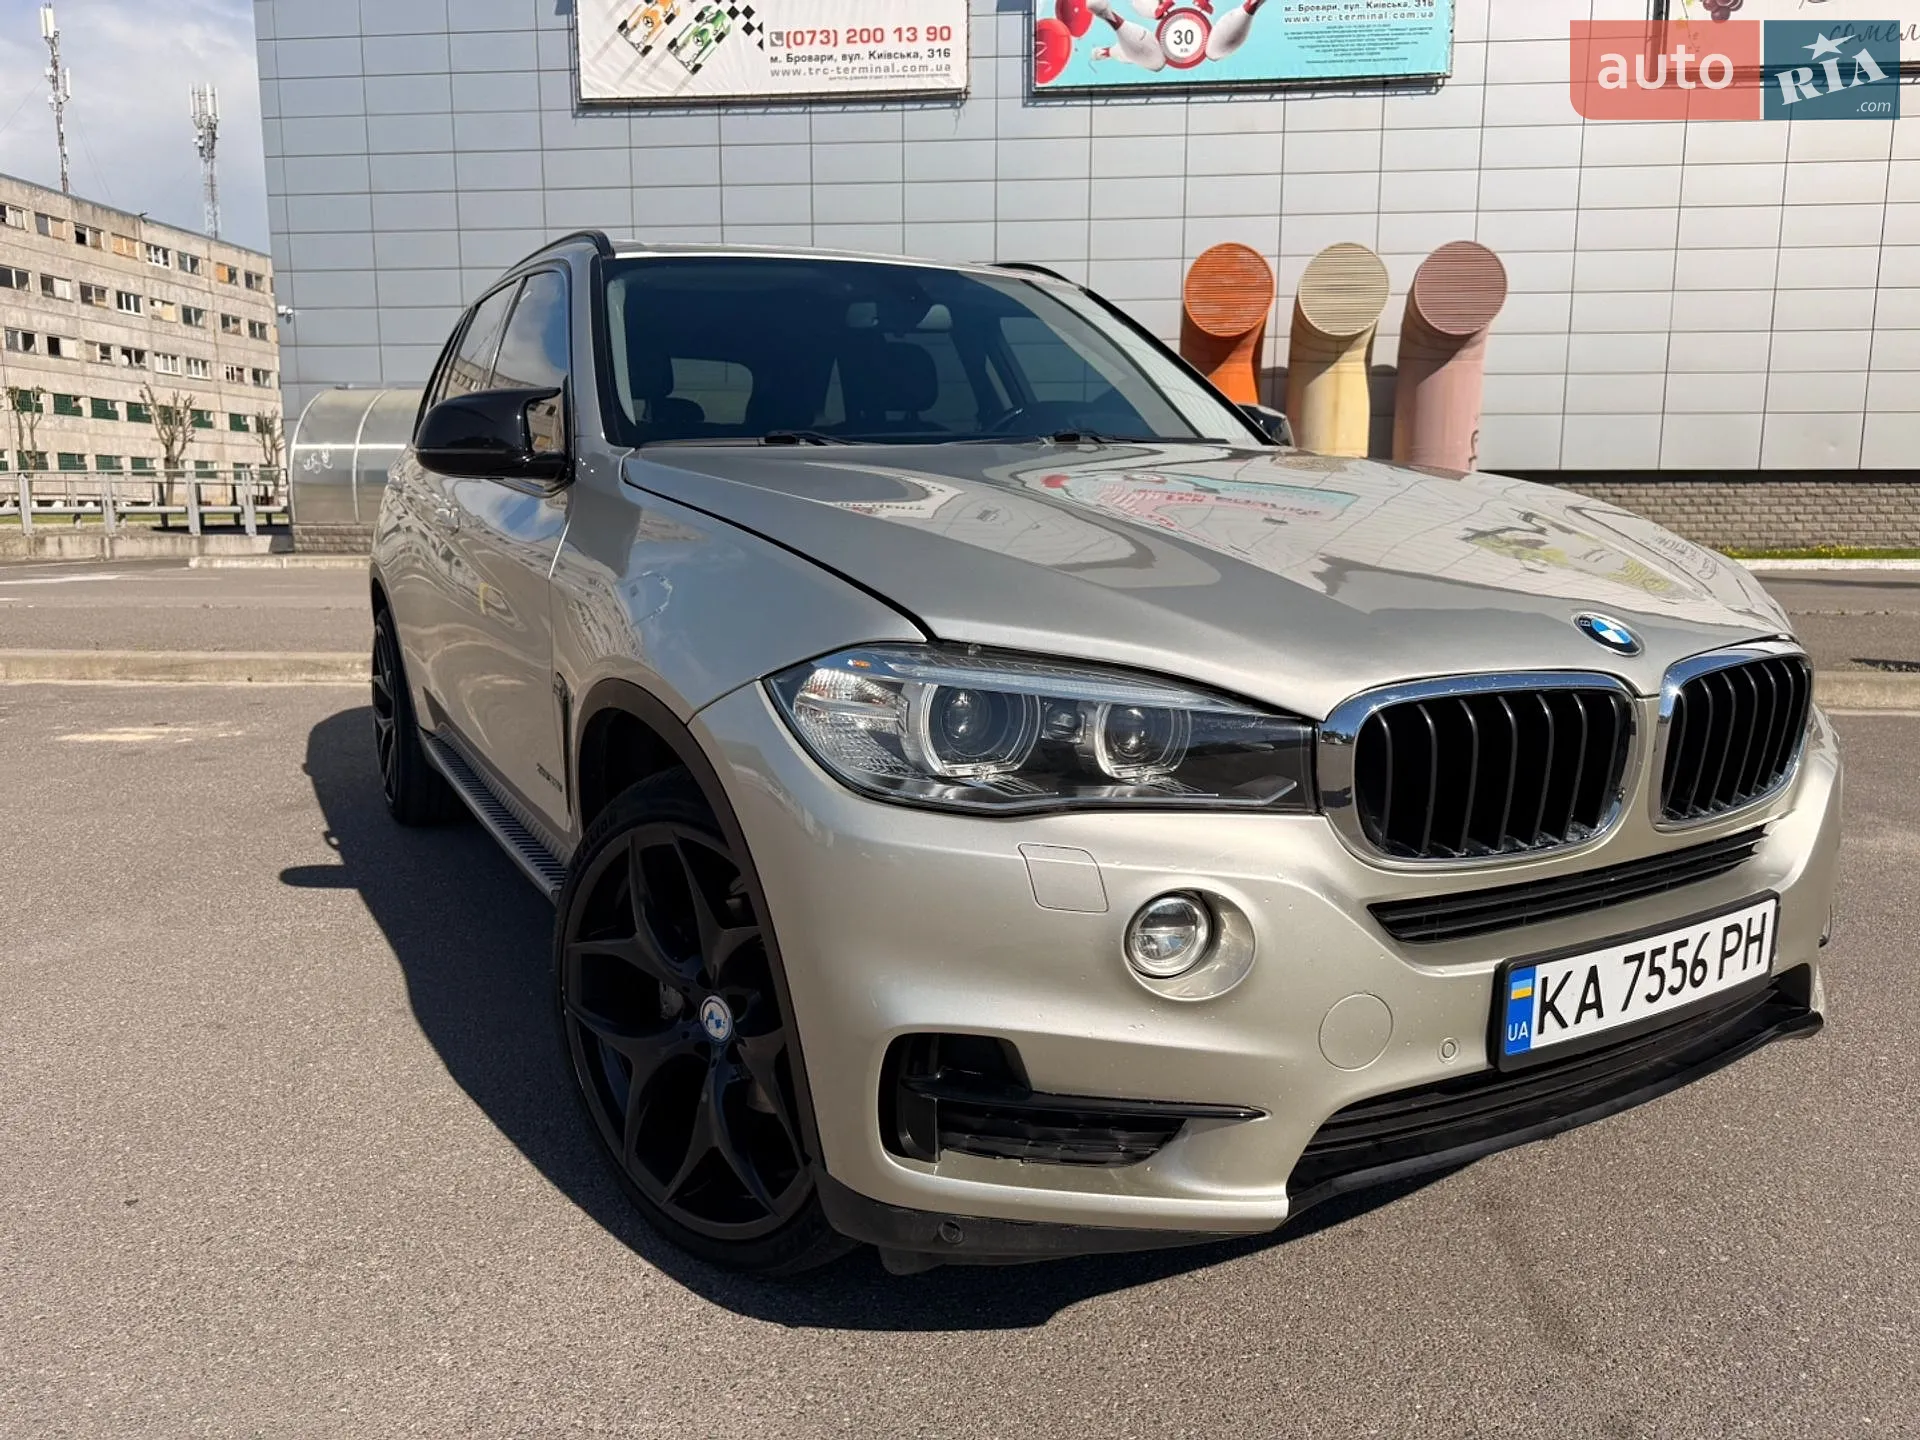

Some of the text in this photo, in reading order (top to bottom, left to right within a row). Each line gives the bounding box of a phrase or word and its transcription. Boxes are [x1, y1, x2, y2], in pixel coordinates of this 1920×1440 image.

[1284, 11, 1434, 23] www.trc-terminal.com.ua
[785, 25, 952, 49] (073) 200 13 90
[1173, 29, 1194, 45] 30
[770, 55, 782, 64] м.
[786, 52, 838, 66] Бровари,
[841, 53, 864, 64] вул.
[927, 48, 951, 58] 316
[770, 62, 951, 78] www.trc-terminal.com.ua
[1537, 911, 1767, 1035] KA 7556 PH
[1507, 1022, 1529, 1041] UA
